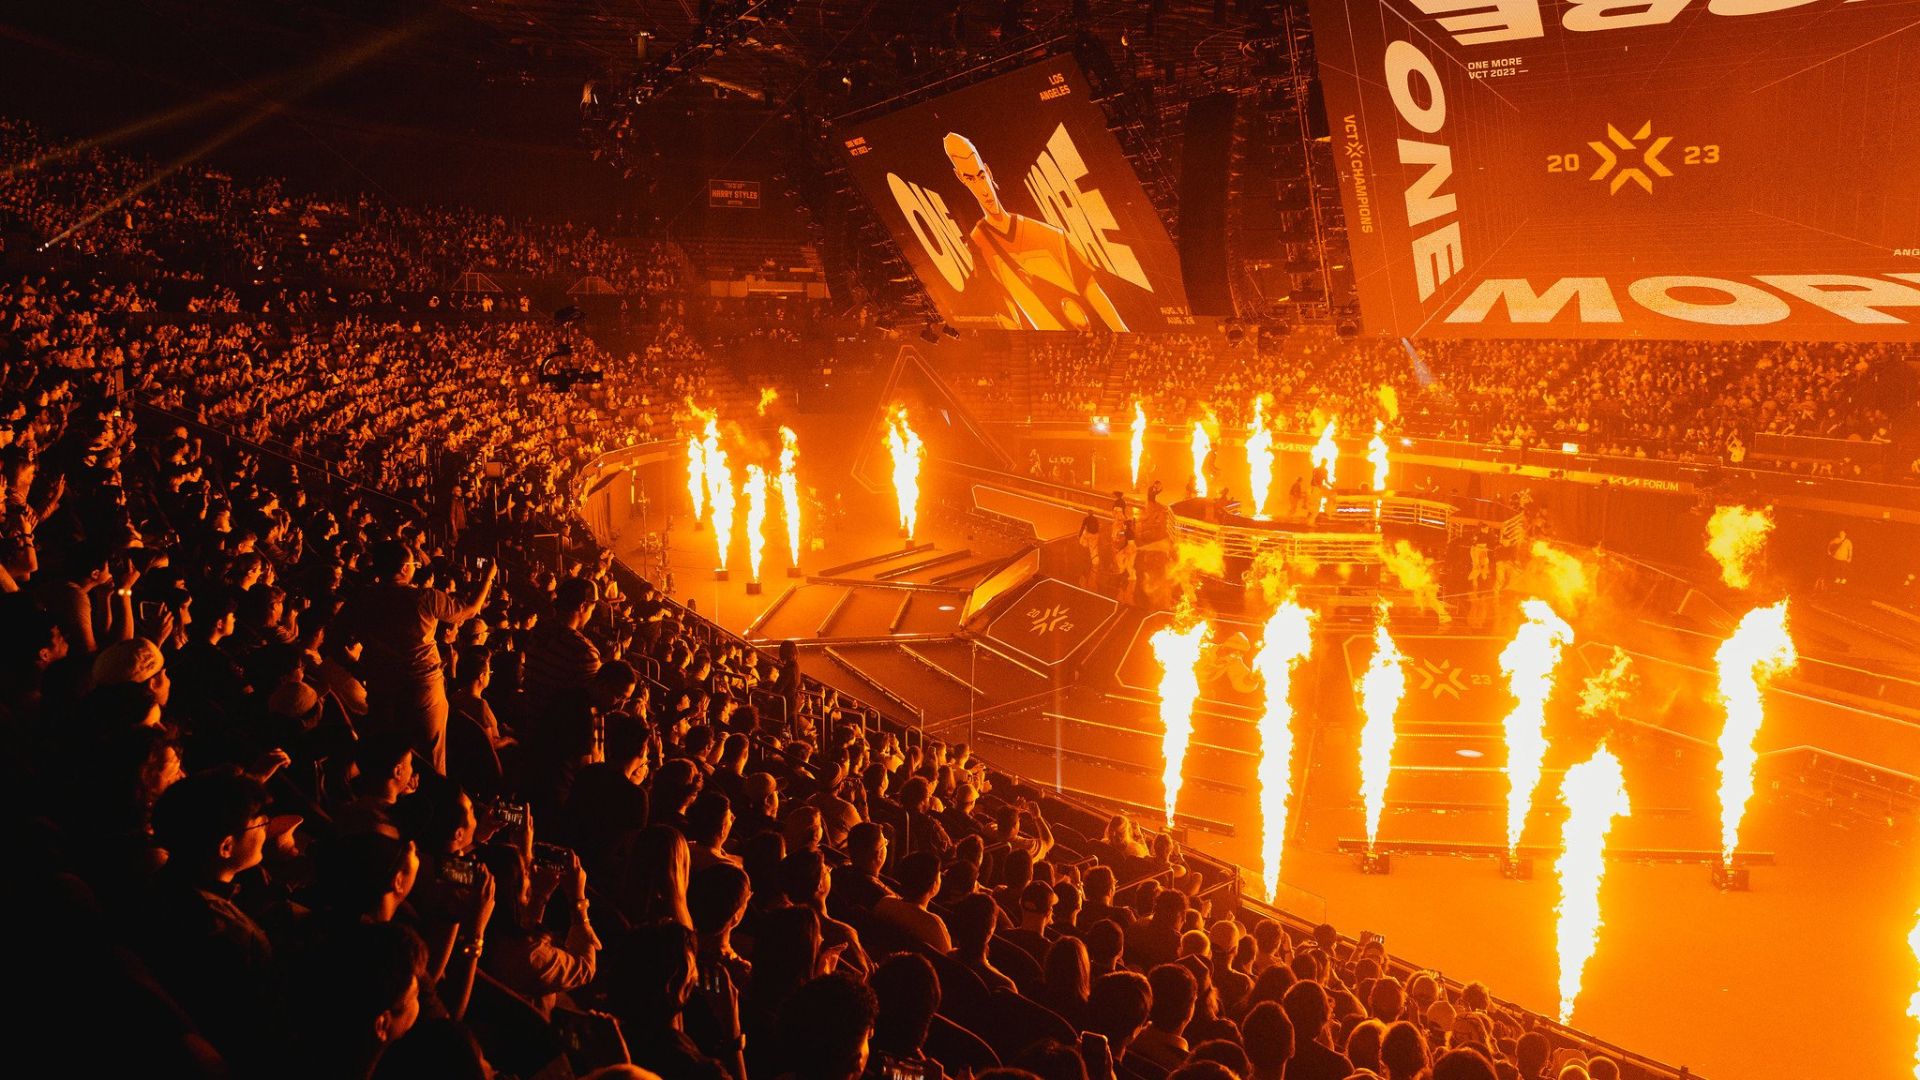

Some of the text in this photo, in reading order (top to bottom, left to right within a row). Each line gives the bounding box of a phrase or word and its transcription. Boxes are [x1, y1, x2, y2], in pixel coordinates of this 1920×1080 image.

[1468, 57, 1522, 69] ONE MORE
[1048, 73, 1064, 85] LOS
[1468, 68, 1516, 79] VCT 2023
[1040, 84, 1071, 101] ANGELES
[1546, 144, 1720, 173] 20 23
[1343, 114, 1373, 233] VCT CHAMPIONS
[1384, 40, 1465, 304] ONE
[712, 189, 758, 200] HARRY STYLES
[1643, 479, 1679, 492] FORUM
[1470, 674, 1493, 686] 23
